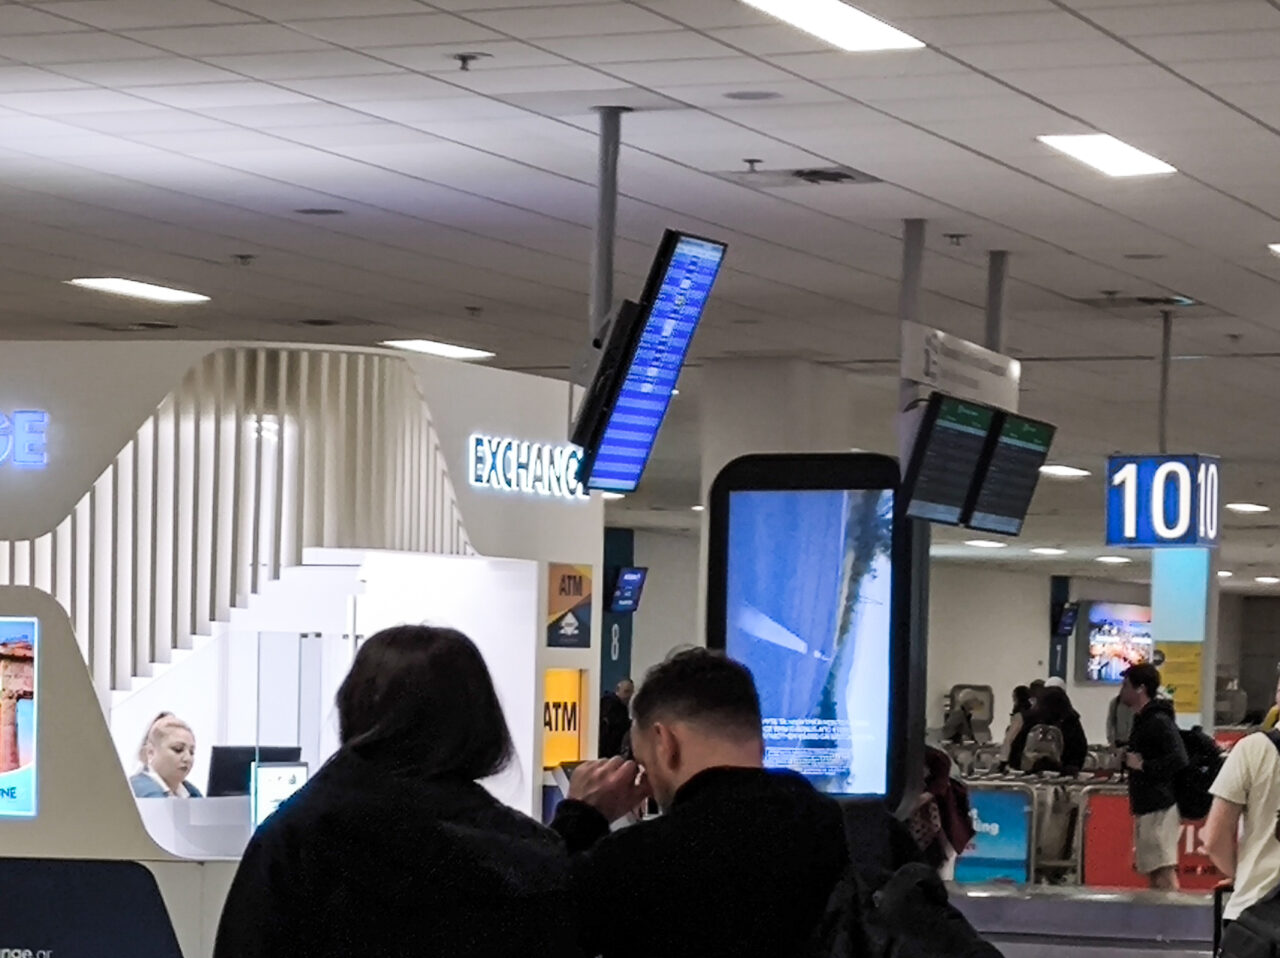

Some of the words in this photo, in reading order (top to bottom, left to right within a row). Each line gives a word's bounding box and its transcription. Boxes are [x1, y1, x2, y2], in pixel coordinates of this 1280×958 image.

[469, 434, 590, 499] EXCHANG
[1112, 461, 1192, 539] 10
[1198, 463, 1218, 539] 10
[559, 574, 583, 596] ATM
[610, 623, 620, 661] 8
[544, 701, 577, 731] ATM
